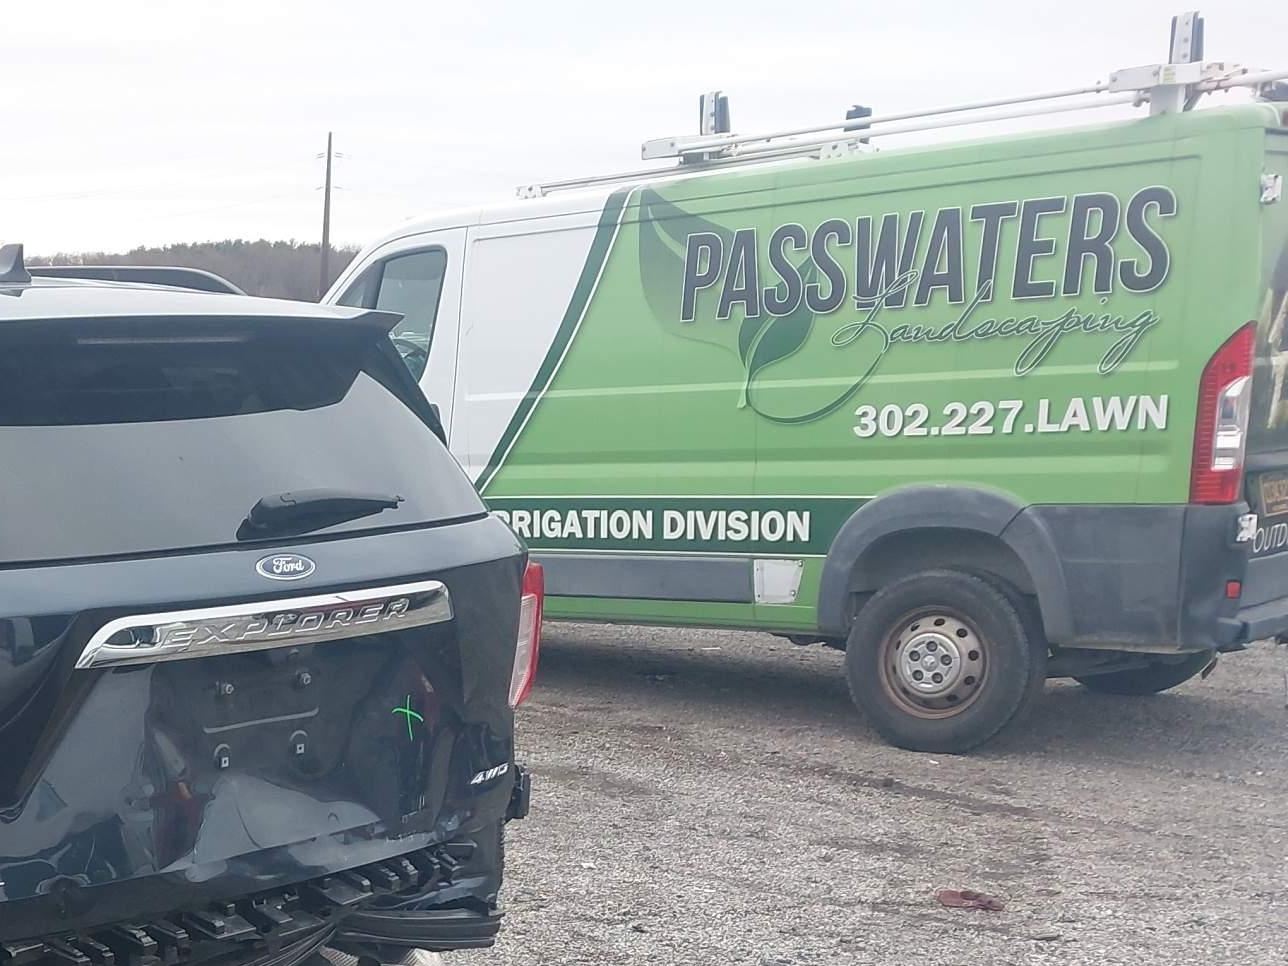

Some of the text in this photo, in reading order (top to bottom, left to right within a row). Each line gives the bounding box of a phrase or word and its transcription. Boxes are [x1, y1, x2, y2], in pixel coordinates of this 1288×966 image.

[679, 185, 1177, 323] PASSWATERS
[830, 270, 1161, 377] Landscaping
[853, 394, 1168, 437] 302.227.LAWN
[663, 510, 810, 541] DIVISION
[1253, 523, 1288, 553] OUTD
[158, 598, 410, 650] EXPLORER
[470, 762, 509, 784] 4WD
